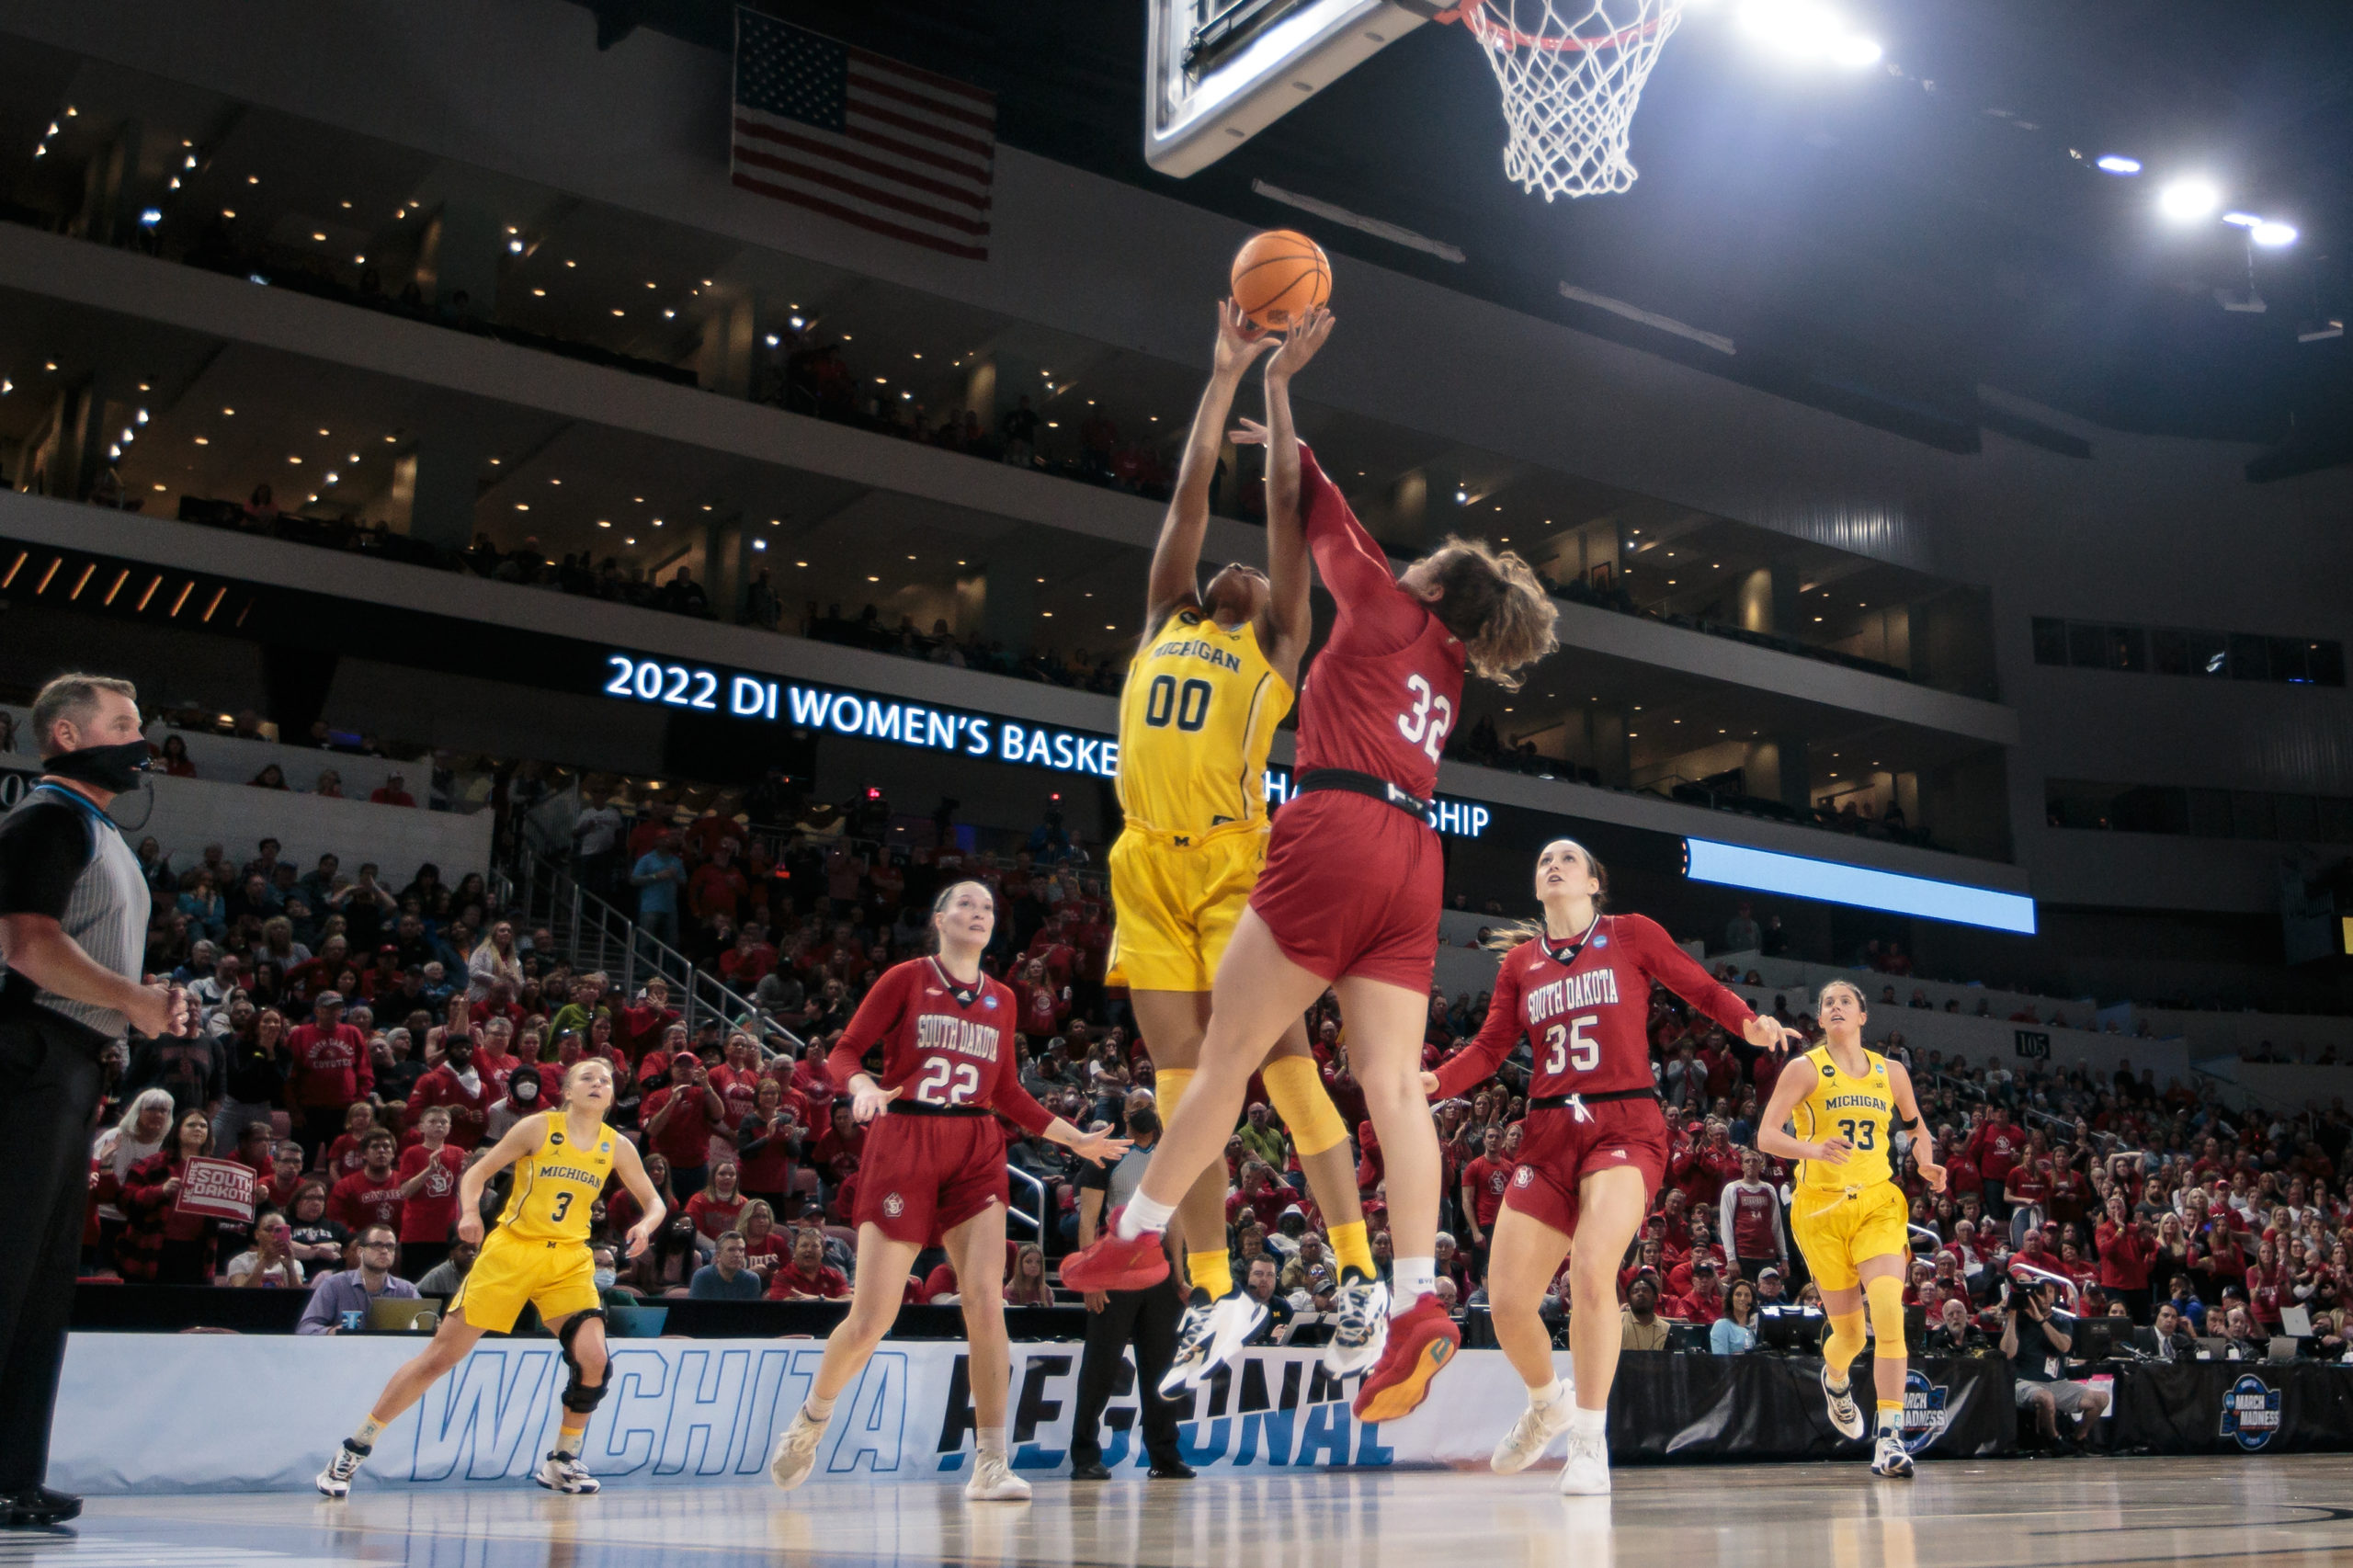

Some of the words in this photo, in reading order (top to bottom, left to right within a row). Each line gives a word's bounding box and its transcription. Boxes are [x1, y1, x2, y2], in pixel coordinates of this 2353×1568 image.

[606, 656, 718, 710] 2022
[733, 676, 779, 720] DI
[790, 686, 989, 756] WOMEN'S
[1002, 724, 1119, 777] BASKE
[1145, 674, 1213, 733] 00
[1397, 673, 1452, 766] 32
[1527, 980, 1564, 1026] SOUTH
[1565, 968, 1619, 1010] DAKOTA
[917, 1014, 959, 1051] SOUTH
[959, 1019, 1000, 1063] DAKOTA
[1545, 1015, 1599, 1075] 35
[2018, 1032, 2046, 1056] 105
[916, 1056, 979, 1105] 22
[1825, 1095, 1887, 1113] MICHIGAN
[1838, 1119, 1876, 1151] 33
[197, 1169, 254, 1192] SOUTH
[540, 1165, 602, 1189] MICHIGAN
[194, 1183, 253, 1203] DAKOTA
[551, 1191, 574, 1222] 3
[1904, 1392, 1928, 1409] ARCH
[2235, 1394, 2265, 1410] MARCH
[1904, 1410, 1945, 1426] ADNESS
[2240, 1411, 2279, 1426] MADNESS
